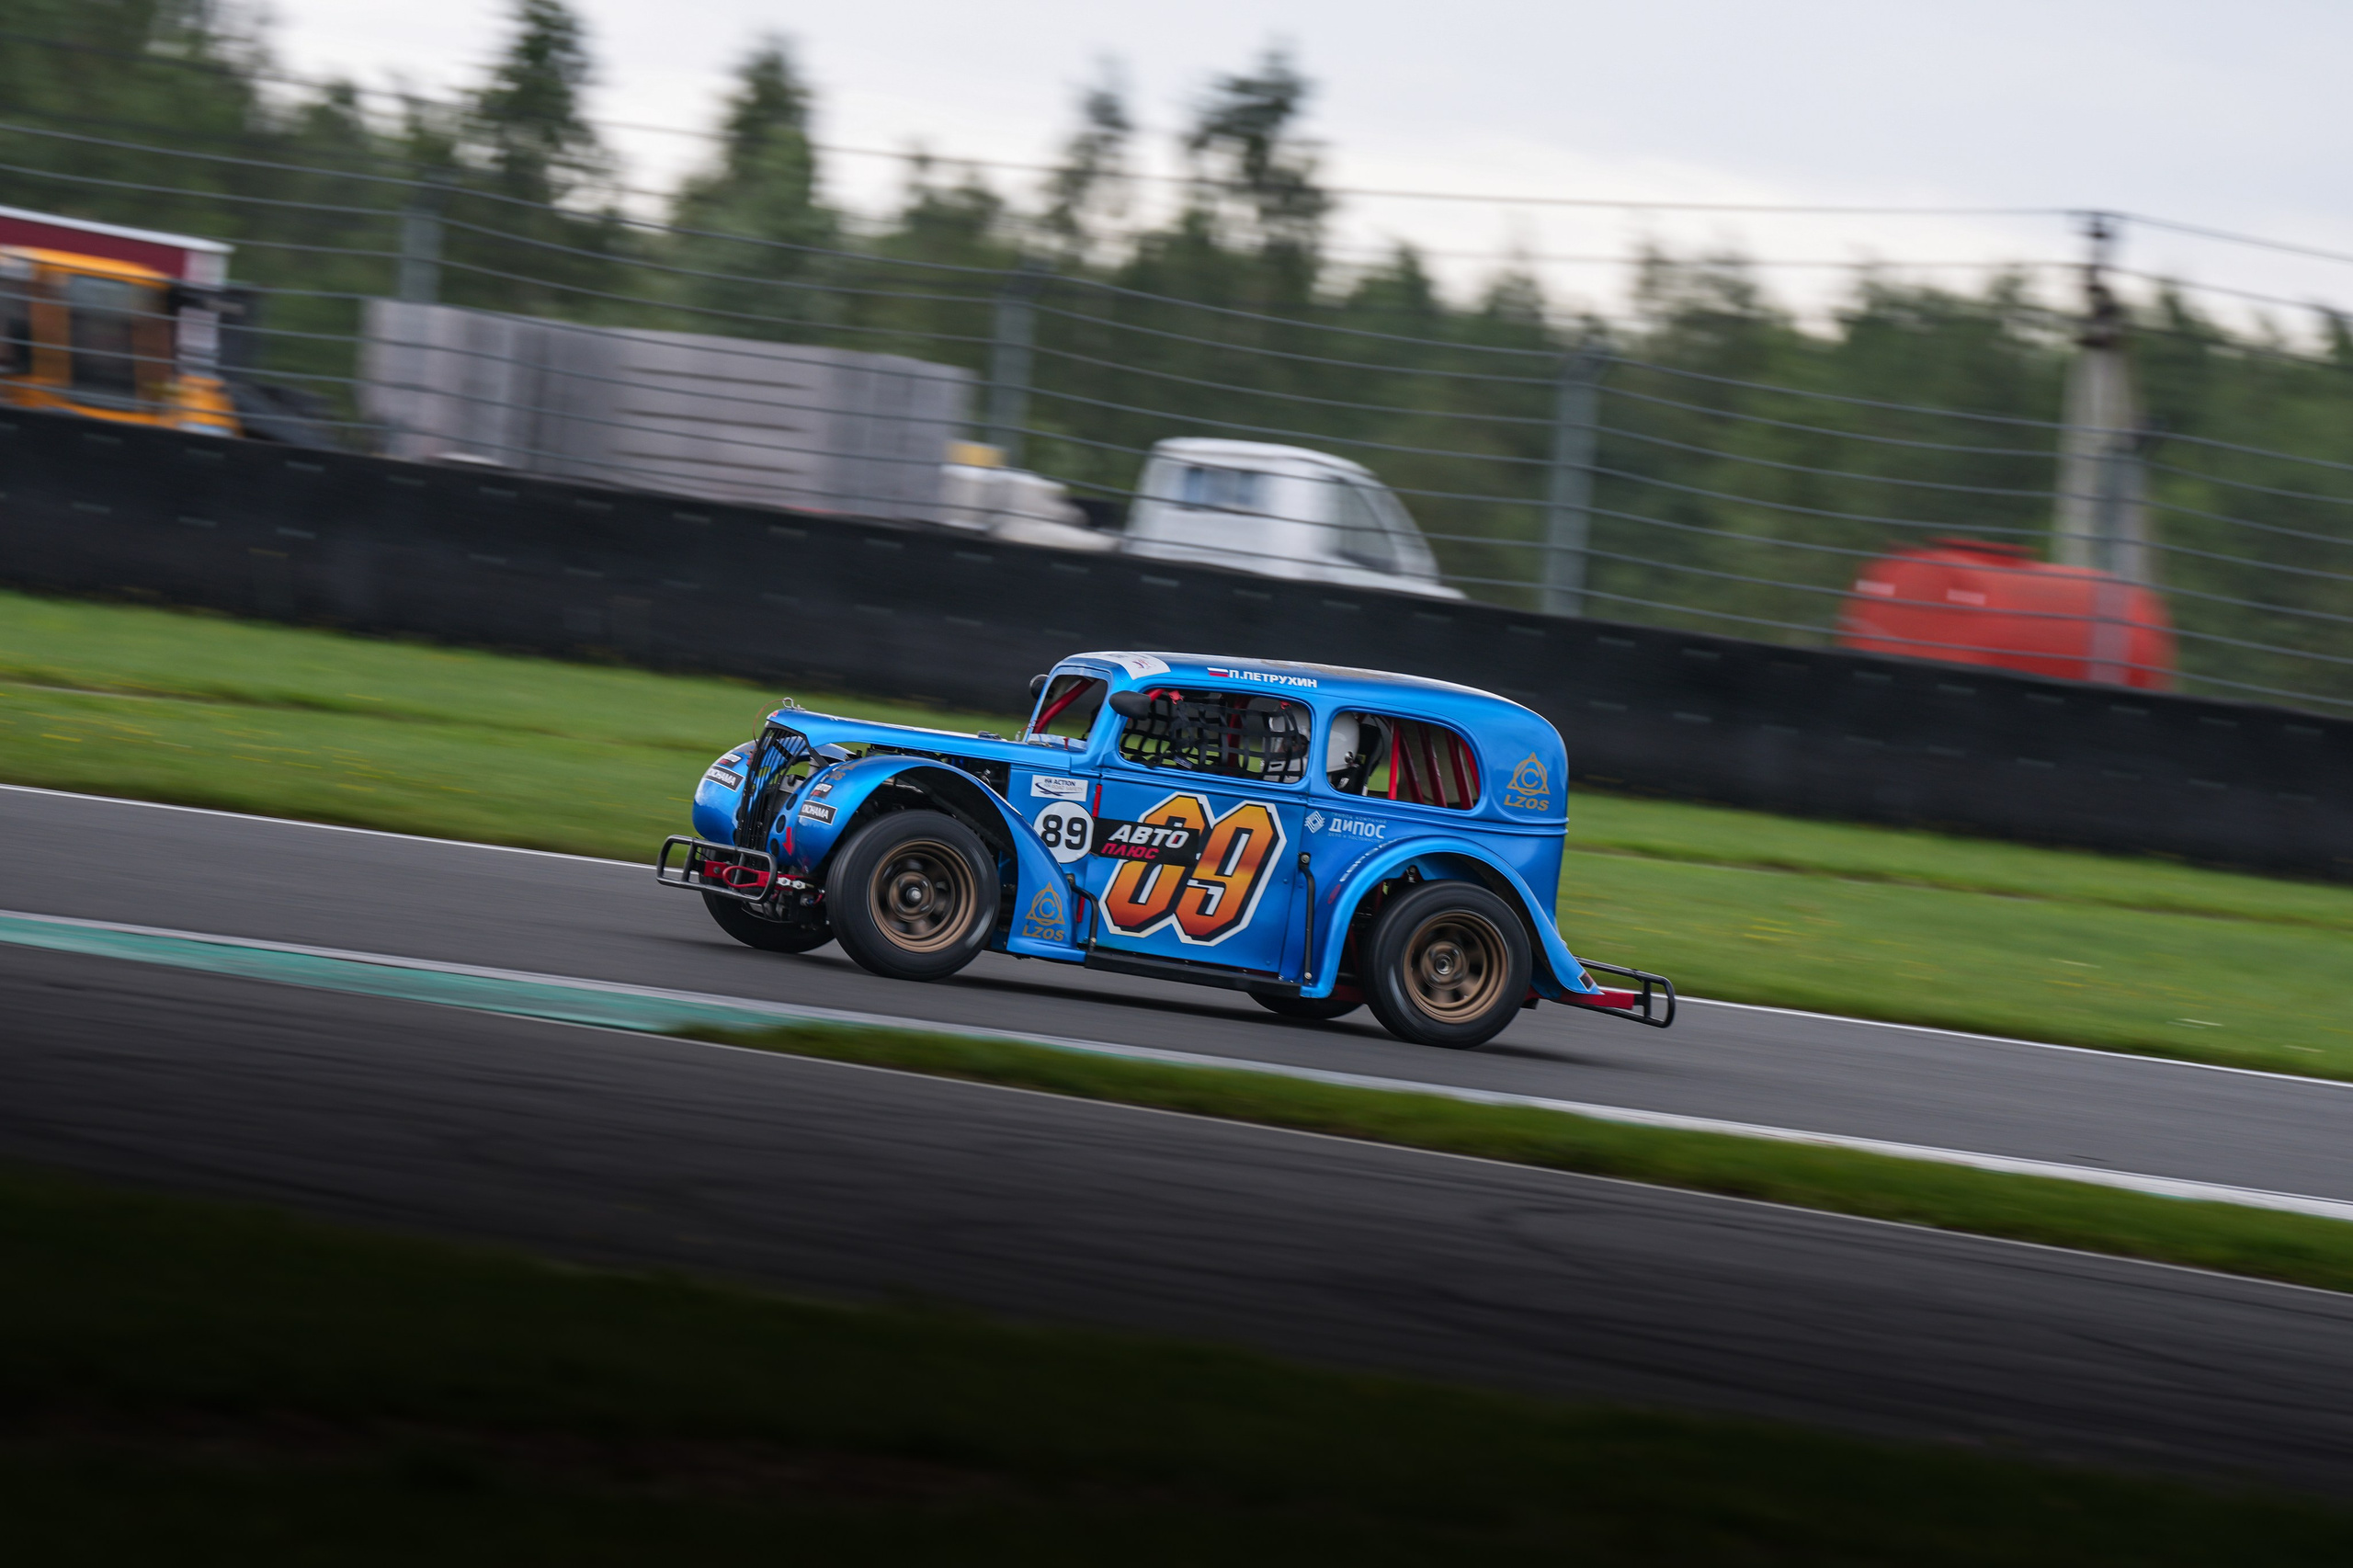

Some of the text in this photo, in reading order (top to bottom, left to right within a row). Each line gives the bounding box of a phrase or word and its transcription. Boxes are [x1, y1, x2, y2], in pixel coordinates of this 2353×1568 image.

[1229, 669, 1318, 688] П.ПЕТРУХИН
[1504, 794, 1550, 812] LZOS
[1040, 814, 1087, 850] 89
[1108, 824, 1189, 848] АВТО
[1328, 818, 1387, 839] ДИПОС
[1100, 843, 1160, 859] ПЛЮС
[1098, 791, 1287, 946] 89
[1022, 925, 1065, 941] LZOS
